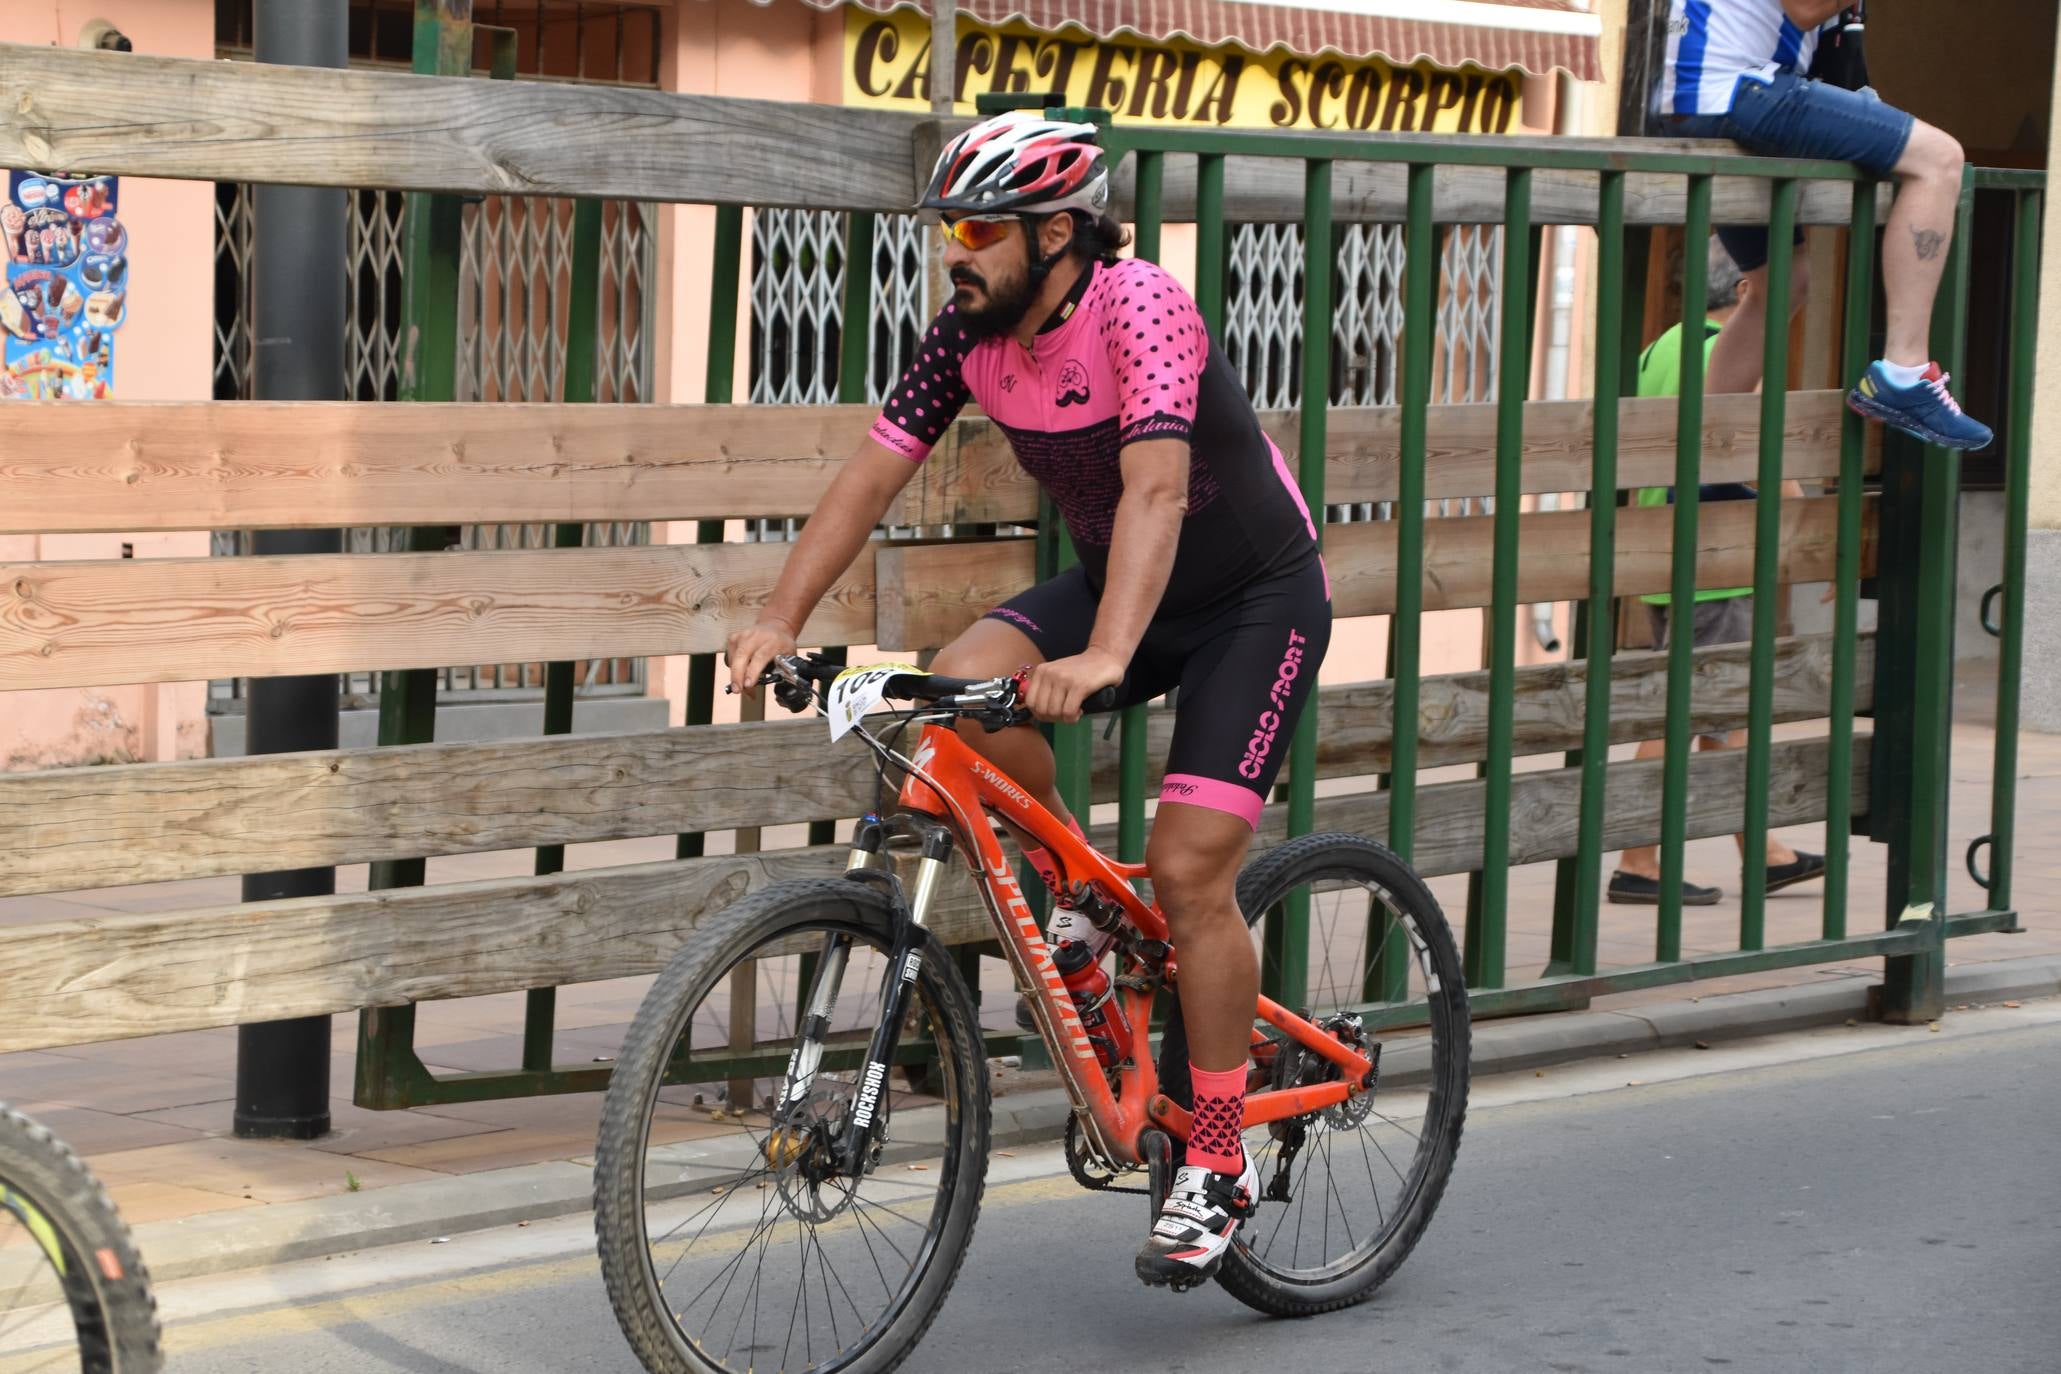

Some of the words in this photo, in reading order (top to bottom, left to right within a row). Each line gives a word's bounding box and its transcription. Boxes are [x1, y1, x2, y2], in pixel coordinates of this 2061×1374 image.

[1270, 56, 1517, 133] SCORPIO
[987, 855, 1096, 1059] SPECIALIZED
[853, 1061, 886, 1128] ROCKSHOX
